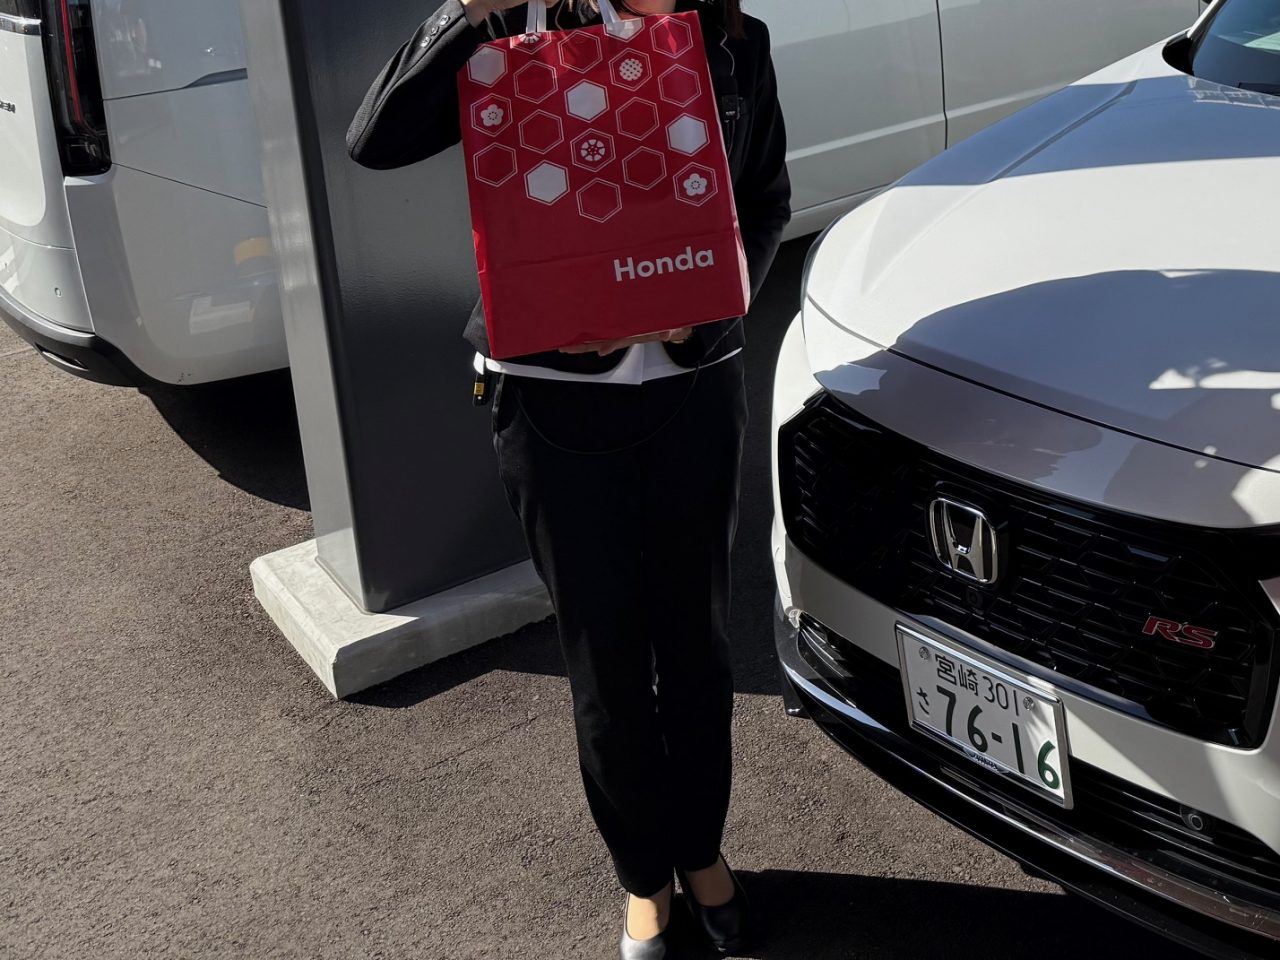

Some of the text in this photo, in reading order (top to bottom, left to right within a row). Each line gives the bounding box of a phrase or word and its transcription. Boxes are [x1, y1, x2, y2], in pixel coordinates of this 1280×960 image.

[613, 245, 715, 282] Honda
[1142, 615, 1219, 650] RS
[934, 653, 1020, 717] 宮崎 301
[917, 685, 1060, 790] さ 76-16
